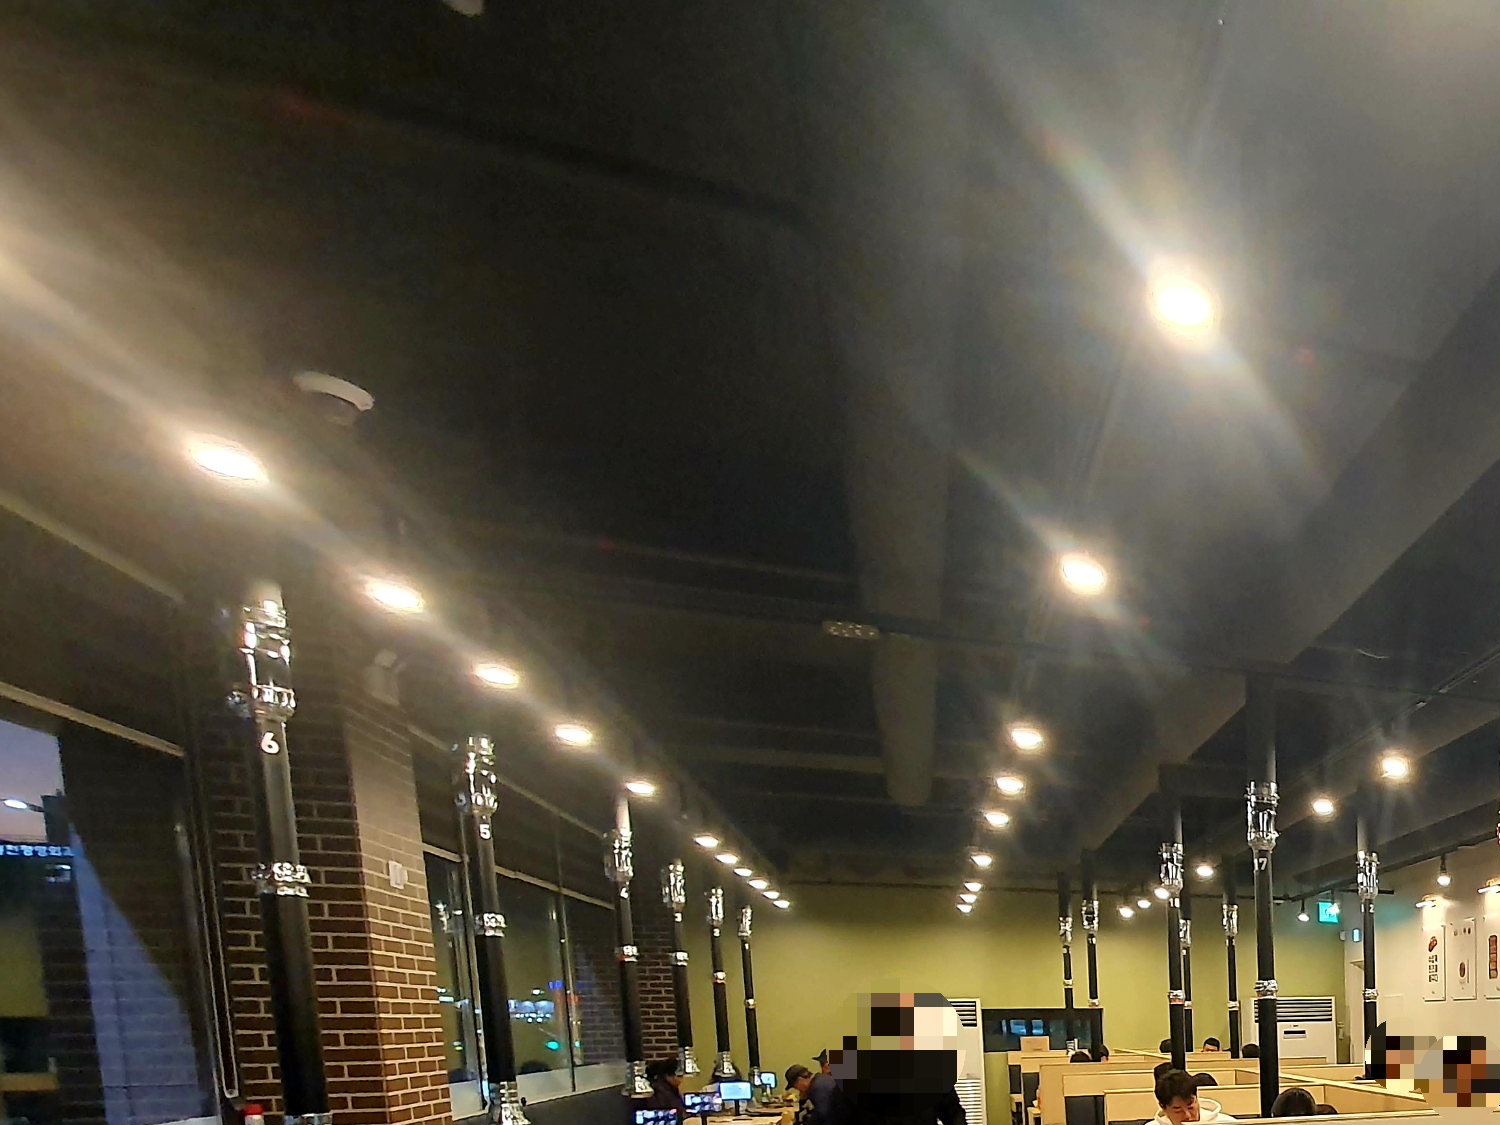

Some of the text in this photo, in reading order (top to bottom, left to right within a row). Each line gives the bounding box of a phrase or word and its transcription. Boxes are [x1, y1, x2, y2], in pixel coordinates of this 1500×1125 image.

[261, 731, 280, 754] 6
[479, 824, 491, 839] 5
[1254, 857, 1267, 870] 17
